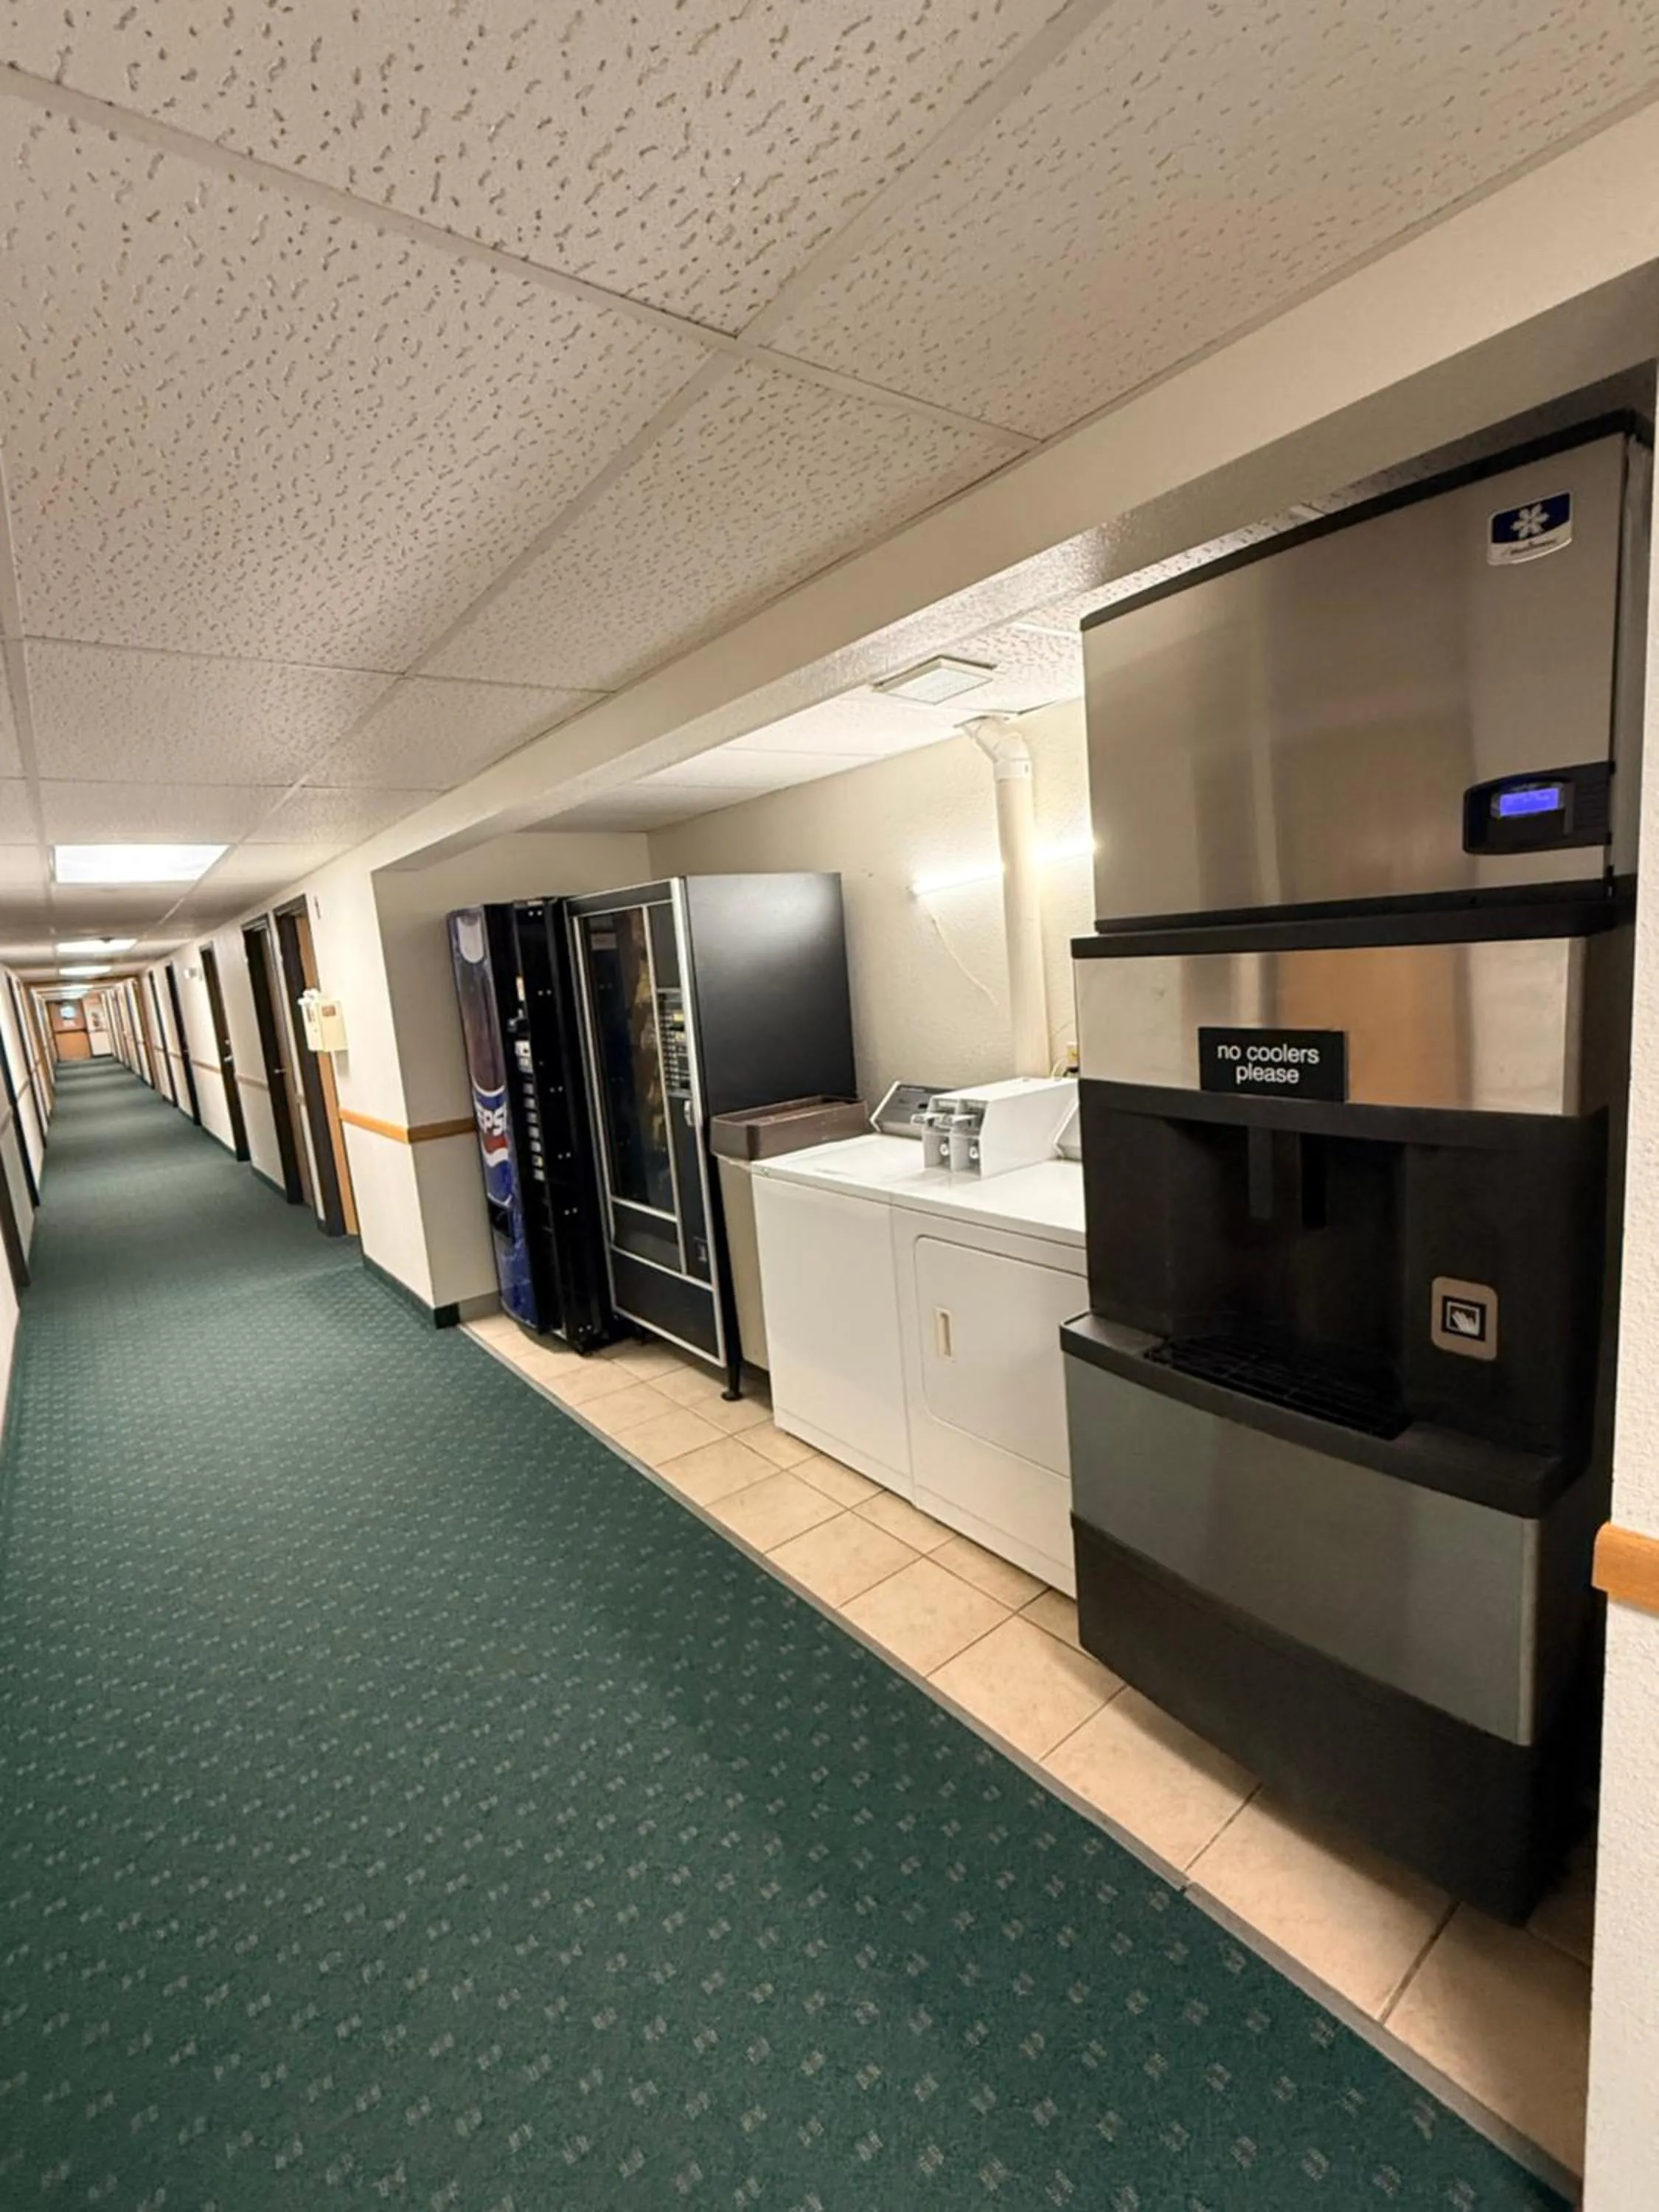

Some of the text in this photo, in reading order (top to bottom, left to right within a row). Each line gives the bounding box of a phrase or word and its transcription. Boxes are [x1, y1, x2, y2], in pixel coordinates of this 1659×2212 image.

[1217, 1043, 1321, 1064] no coolers
[1236, 1062, 1299, 1085] please
